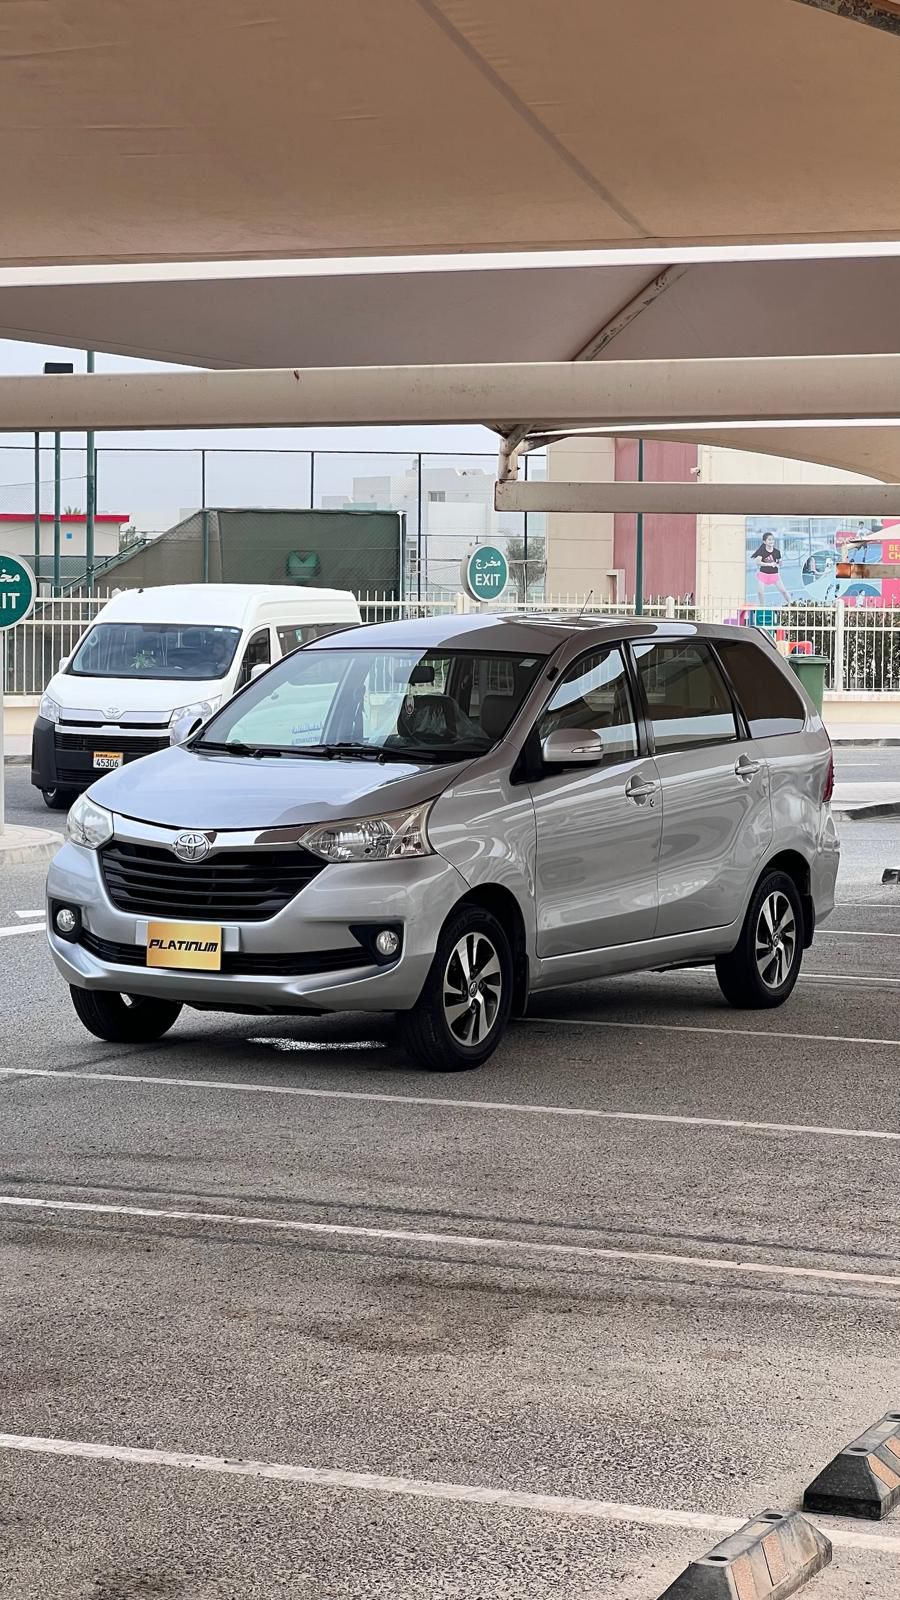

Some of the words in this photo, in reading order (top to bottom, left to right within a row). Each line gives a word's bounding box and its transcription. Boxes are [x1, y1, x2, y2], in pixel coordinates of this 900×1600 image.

[475, 556, 501, 570] مخرج
[0, 568, 20, 583] مخ
[475, 573, 501, 586] EXIT
[0, 592, 20, 609] IT
[96, 759, 119, 768] 45306
[148, 939, 219, 953] PLATINUM
